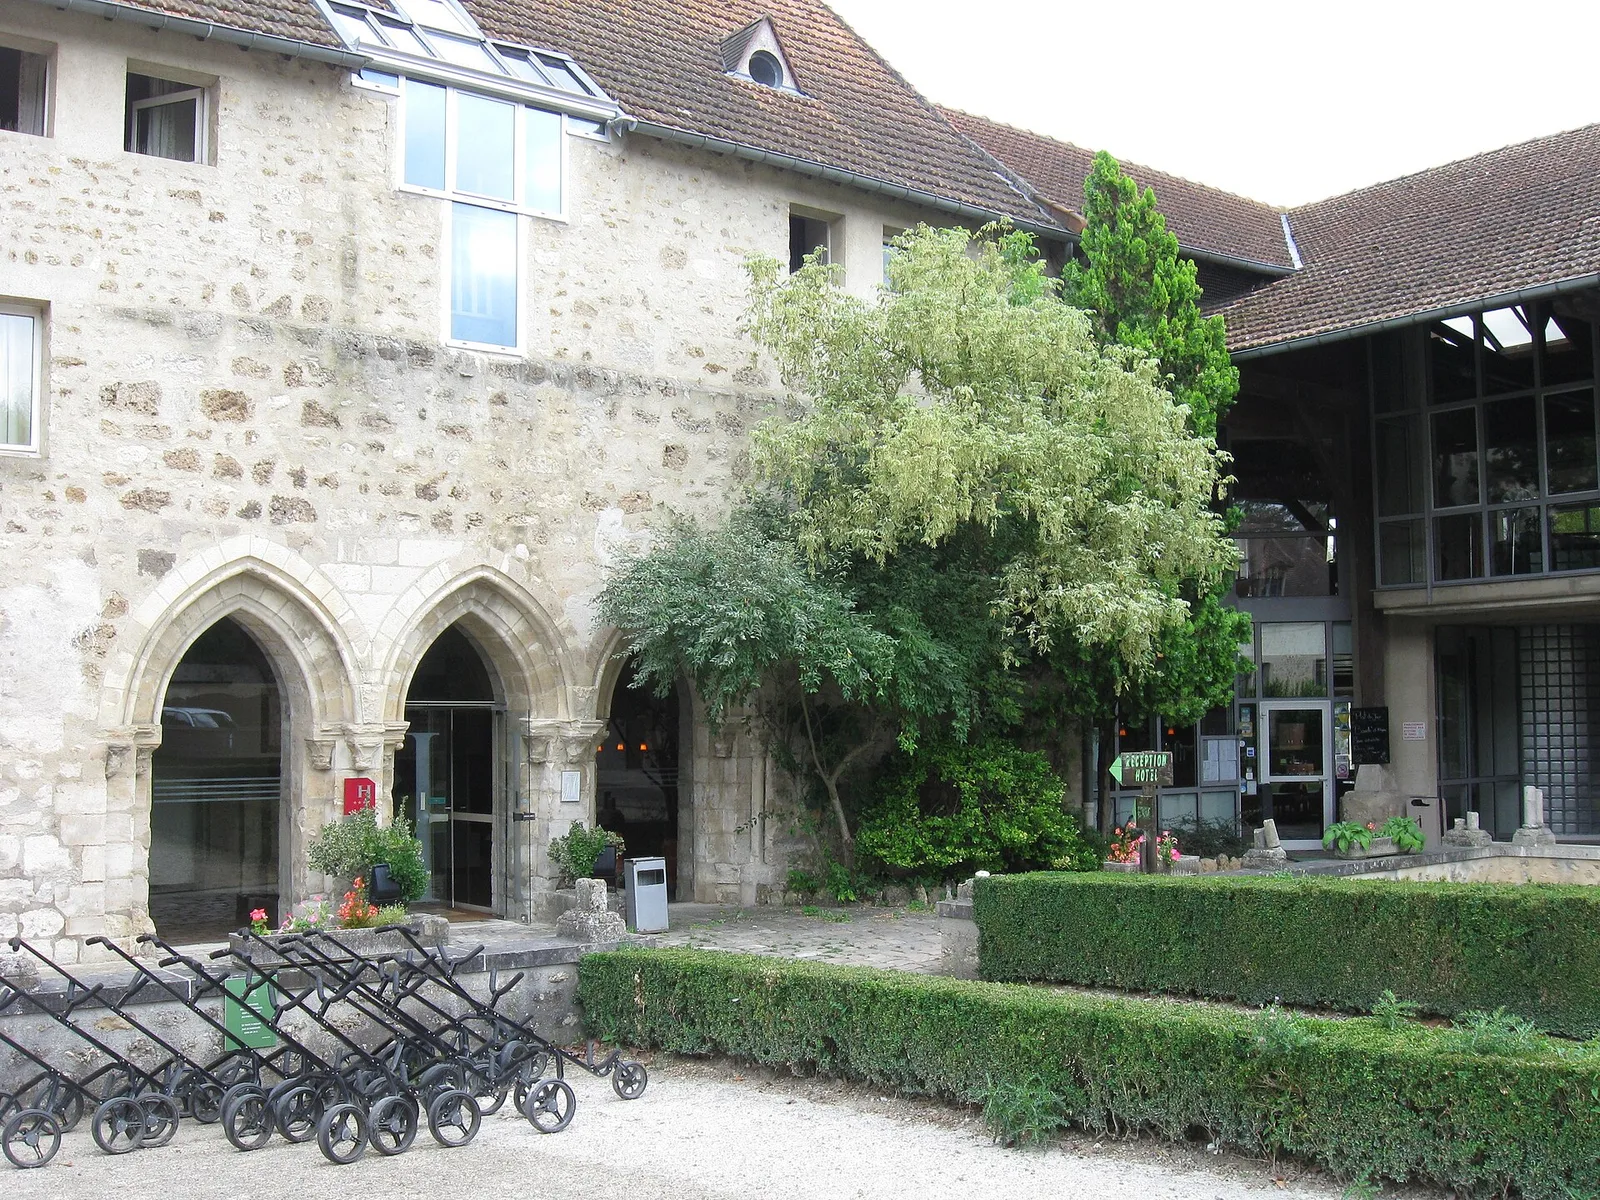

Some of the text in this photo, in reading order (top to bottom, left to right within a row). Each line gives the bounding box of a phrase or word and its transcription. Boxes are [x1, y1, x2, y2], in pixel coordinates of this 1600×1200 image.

[1125, 754, 1168, 768] RECEPTION
[1135, 769, 1159, 782] HOTEL
[357, 784, 372, 799] H
